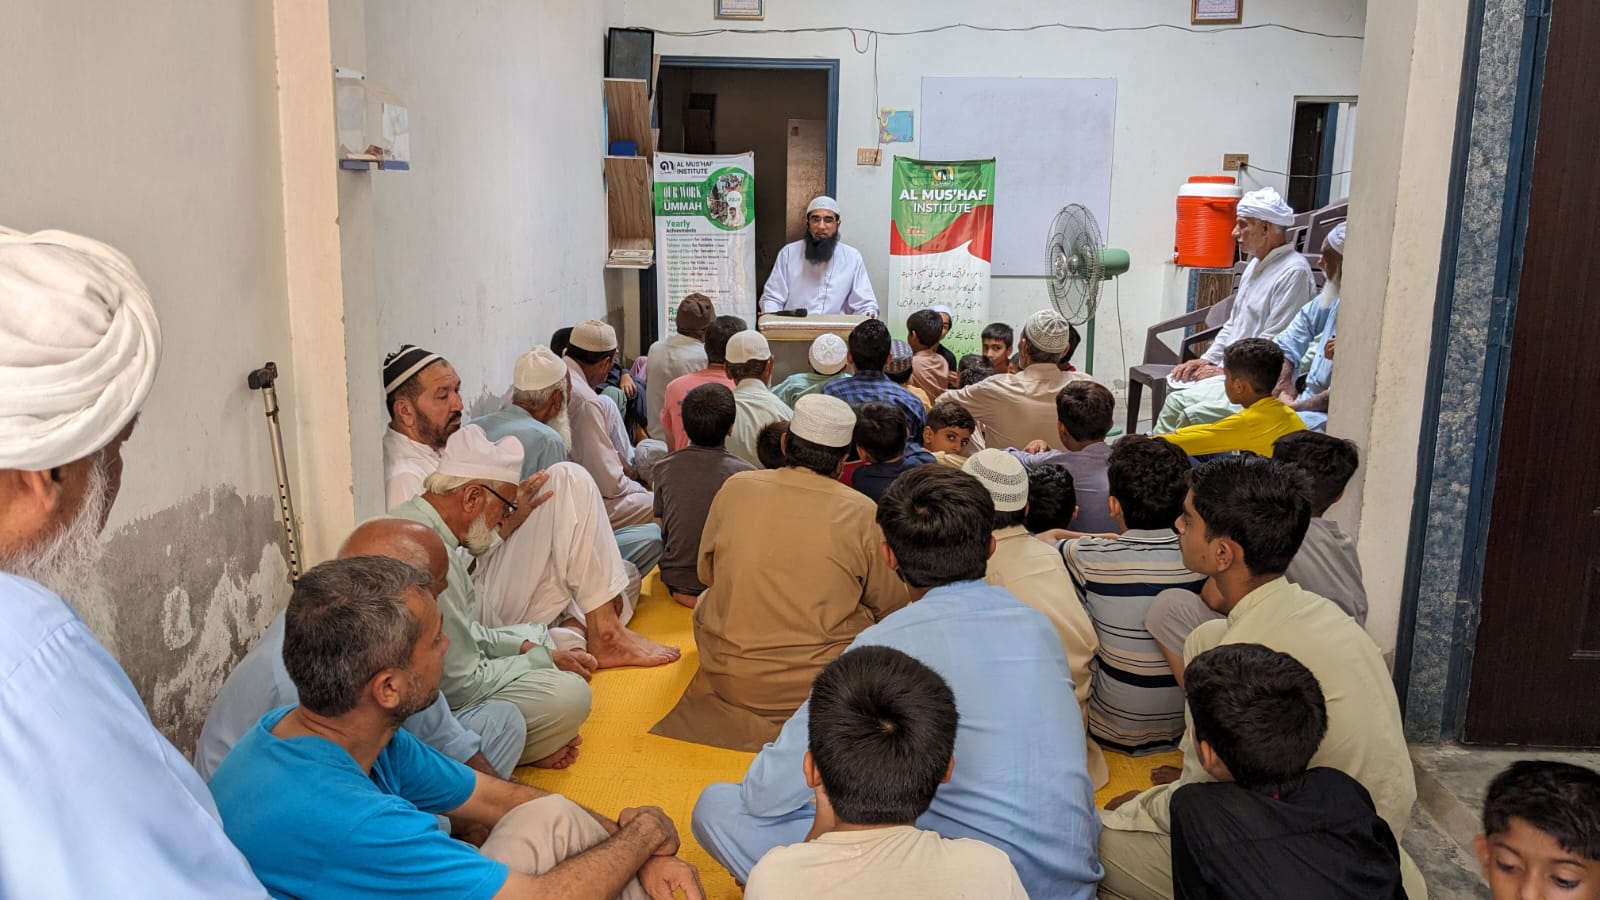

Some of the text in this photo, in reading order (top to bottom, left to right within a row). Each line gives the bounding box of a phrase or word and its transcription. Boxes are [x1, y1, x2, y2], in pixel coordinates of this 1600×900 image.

[663, 185, 702, 199] OUR WORK
[899, 189, 987, 201] AL MUS'HAF
[663, 202, 702, 211] UMMAH
[913, 203, 972, 213] INSTITUTE
[665, 219, 690, 229] Yearly
